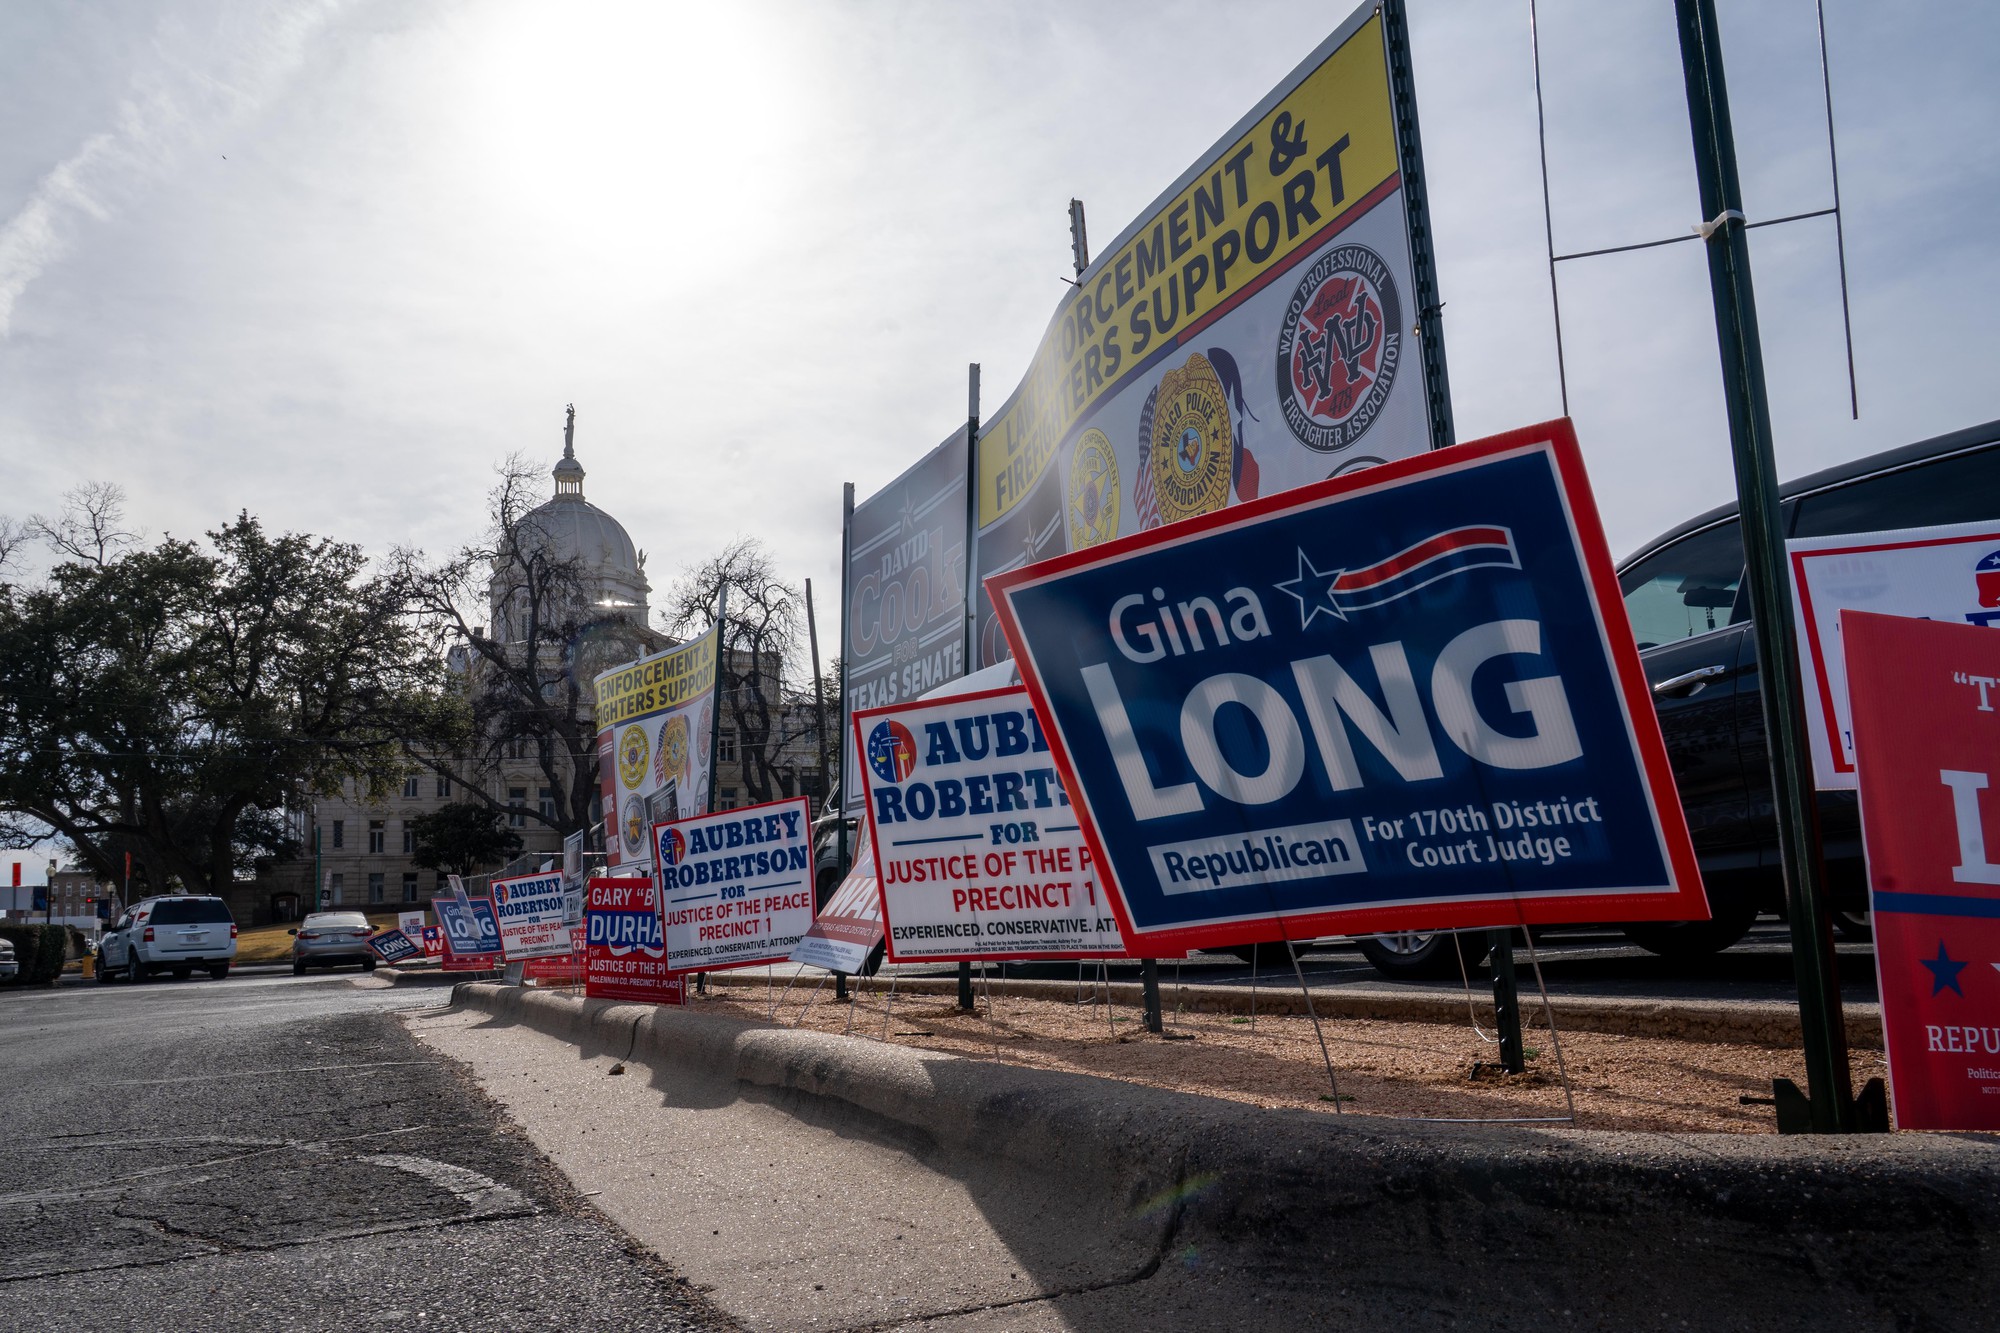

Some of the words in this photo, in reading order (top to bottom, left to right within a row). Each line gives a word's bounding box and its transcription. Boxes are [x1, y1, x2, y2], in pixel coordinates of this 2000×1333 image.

[1005, 383, 1035, 457] LAW
[1036, 145, 1254, 408] ENFORCEMENT
[1268, 110, 1308, 176] &
[1279, 299, 1301, 356] WACO
[1299, 248, 1388, 300] PROFESSIONAL
[996, 324, 1122, 512] FIREFIGHTERS
[1130, 132, 1351, 354] SUPPORT
[1282, 394, 1343, 447] FIREFIGHTER
[1346, 332, 1400, 441] ASSOCIATION
[1328, 386, 1353, 416] 478
[1160, 401, 1183, 448] WACO
[1186, 392, 1216, 425] POLICE
[1163, 451, 1221, 506] ASSOCIATION
[1182, 466, 1201, 481] TEXAS
[880, 530, 929, 581] DAVID
[1108, 585, 1272, 664] Gina
[893, 642, 918, 667] FOR
[600, 644, 701, 702] ENFORCEMENT
[702, 640, 709, 662] &
[658, 659, 714, 706] SUPPORT
[849, 671, 898, 712] TEXAS
[901, 639, 961, 698] SENATE
[1079, 618, 1584, 822] LONG
[689, 810, 801, 855] AUBREY
[989, 821, 1040, 845] FOR
[1361, 812, 1405, 842] For
[1410, 798, 1489, 839] 170th
[1493, 795, 1602, 831] District
[1162, 831, 1350, 886] Republican
[1405, 834, 1483, 868] Court
[1487, 830, 1572, 866] Judge
[662, 845, 808, 890] ROBERTSON
[886, 854, 979, 884] JUSTICE
[984, 853, 1017, 877] OF
[1022, 847, 1073, 875] THE
[510, 878, 561, 899] AUBREY
[592, 887, 633, 906] GARY
[720, 885, 745, 900] FOR
[952, 882, 1072, 913] PRECINCT
[1084, 881, 1096, 906] 1
[497, 896, 563, 918] ROBERTSON
[528, 916, 541, 924] FOR
[666, 904, 715, 927] JUSTICE
[716, 902, 733, 919] OF
[735, 897, 762, 917] THE
[764, 892, 810, 912] PEACE
[502, 925, 527, 937] JUSTICE
[527, 924, 536, 934] OF
[537, 923, 549, 933] THE
[520, 934, 549, 945] PRECINCT
[590, 914, 664, 944] DURHA
[699, 919, 760, 942] PRECINCT
[766, 917, 772, 933] 1
[892, 923, 984, 940] EXPERIENCED.
[987, 918, 1092, 936] CONSERVATIVE.
[374, 937, 411, 956] LONG
[588, 947, 601, 958] For
[668, 947, 714, 960] EXPERIENCED.
[714, 940, 768, 954] CONSERVATIVE.
[588, 958, 624, 972] JUSTICE
[625, 961, 638, 973] OF
[639, 962, 656, 974] THE
[588, 975, 619, 985] McLENNAN
[619, 977, 629, 985] CO.
[629, 977, 656, 987] PRECINCT
[662, 980, 679, 989] PLACE
